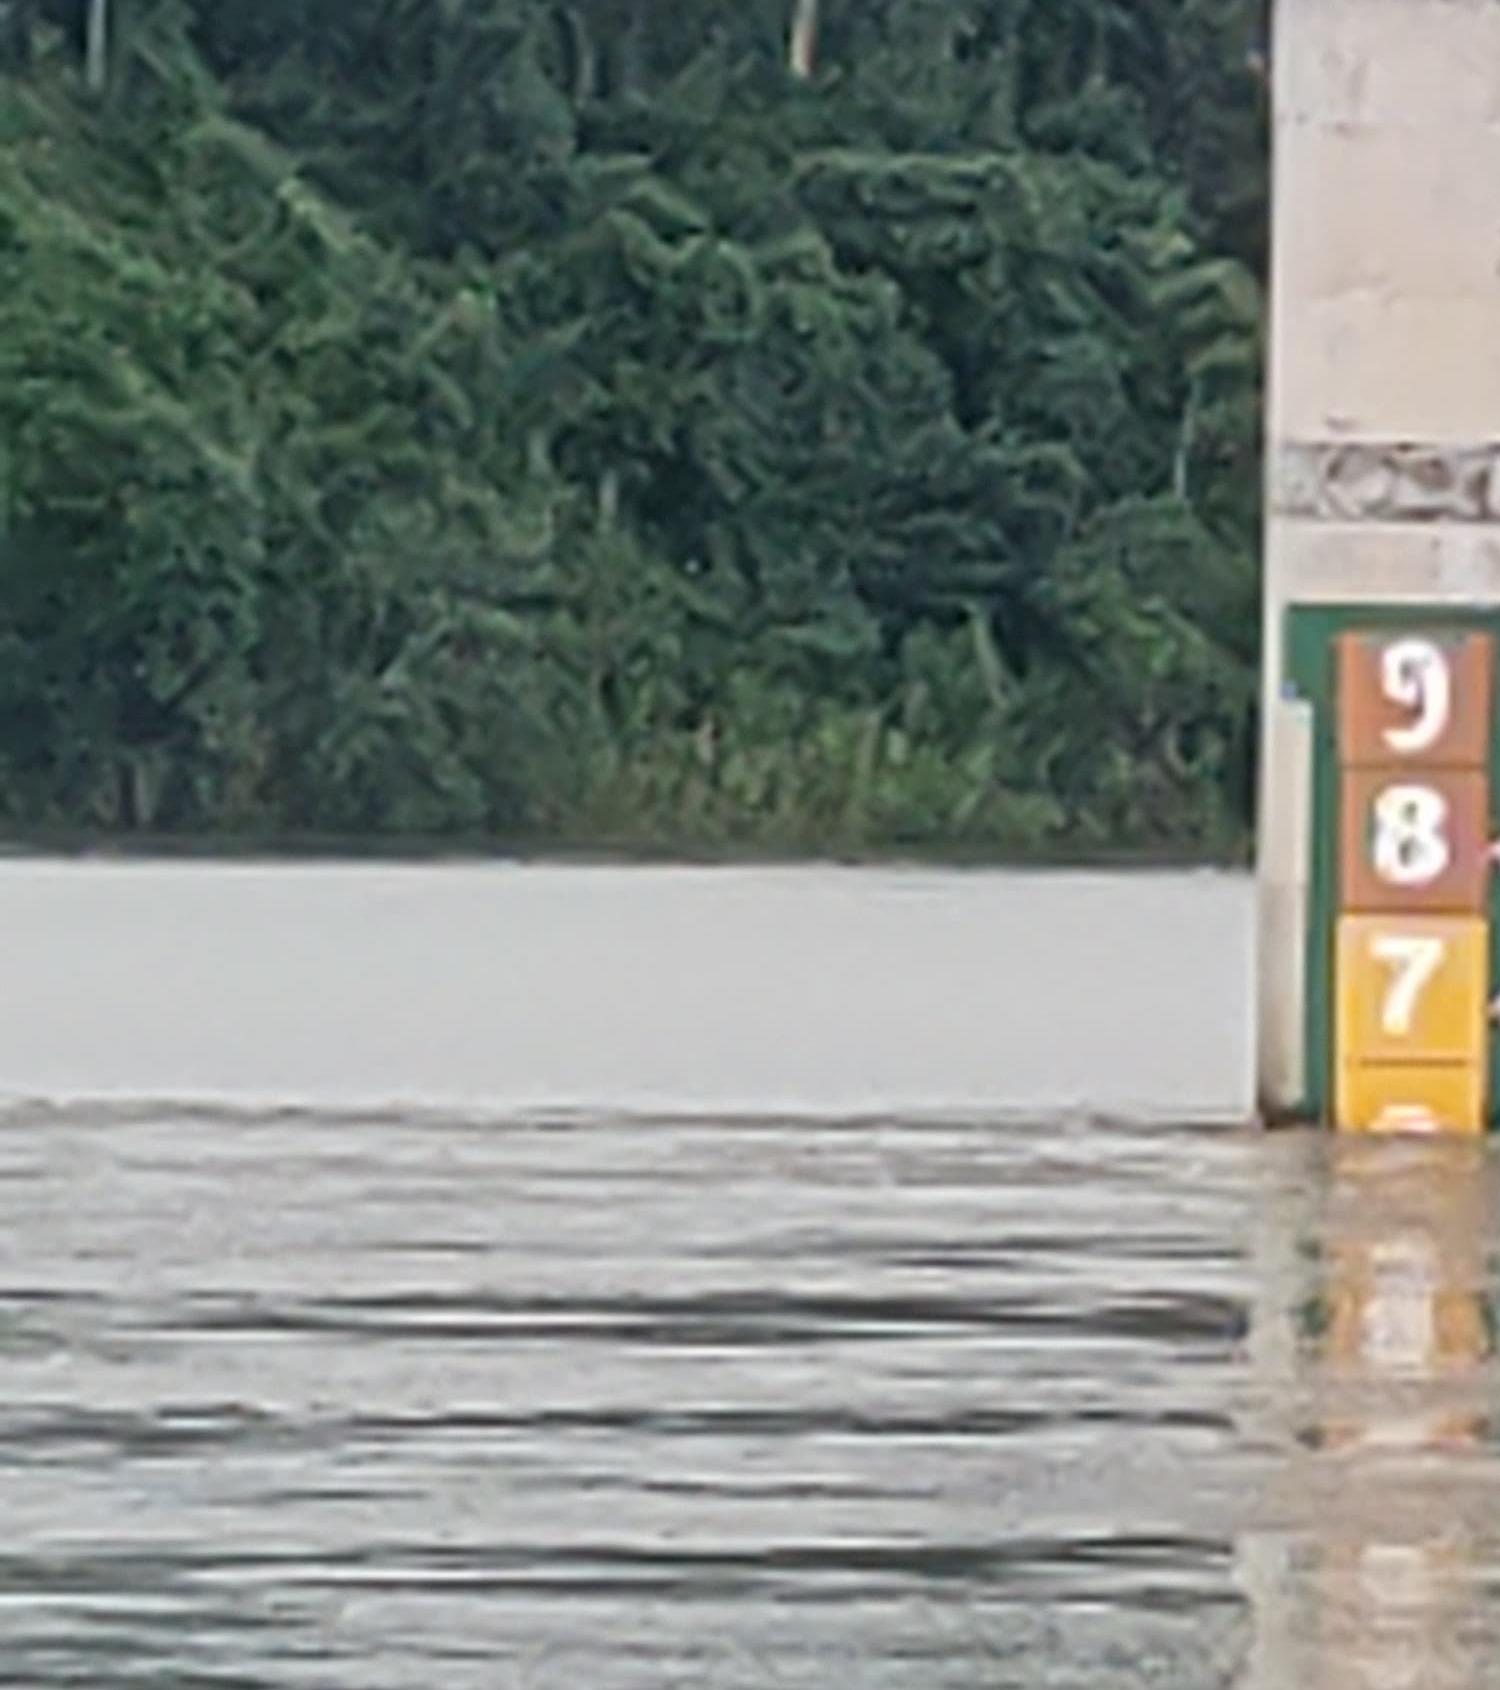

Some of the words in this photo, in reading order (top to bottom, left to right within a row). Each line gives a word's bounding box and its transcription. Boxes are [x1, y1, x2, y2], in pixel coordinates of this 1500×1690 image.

[1381, 639, 1451, 753] 9
[1372, 785, 1451, 885] 8
[1369, 935, 1443, 1035] 7
